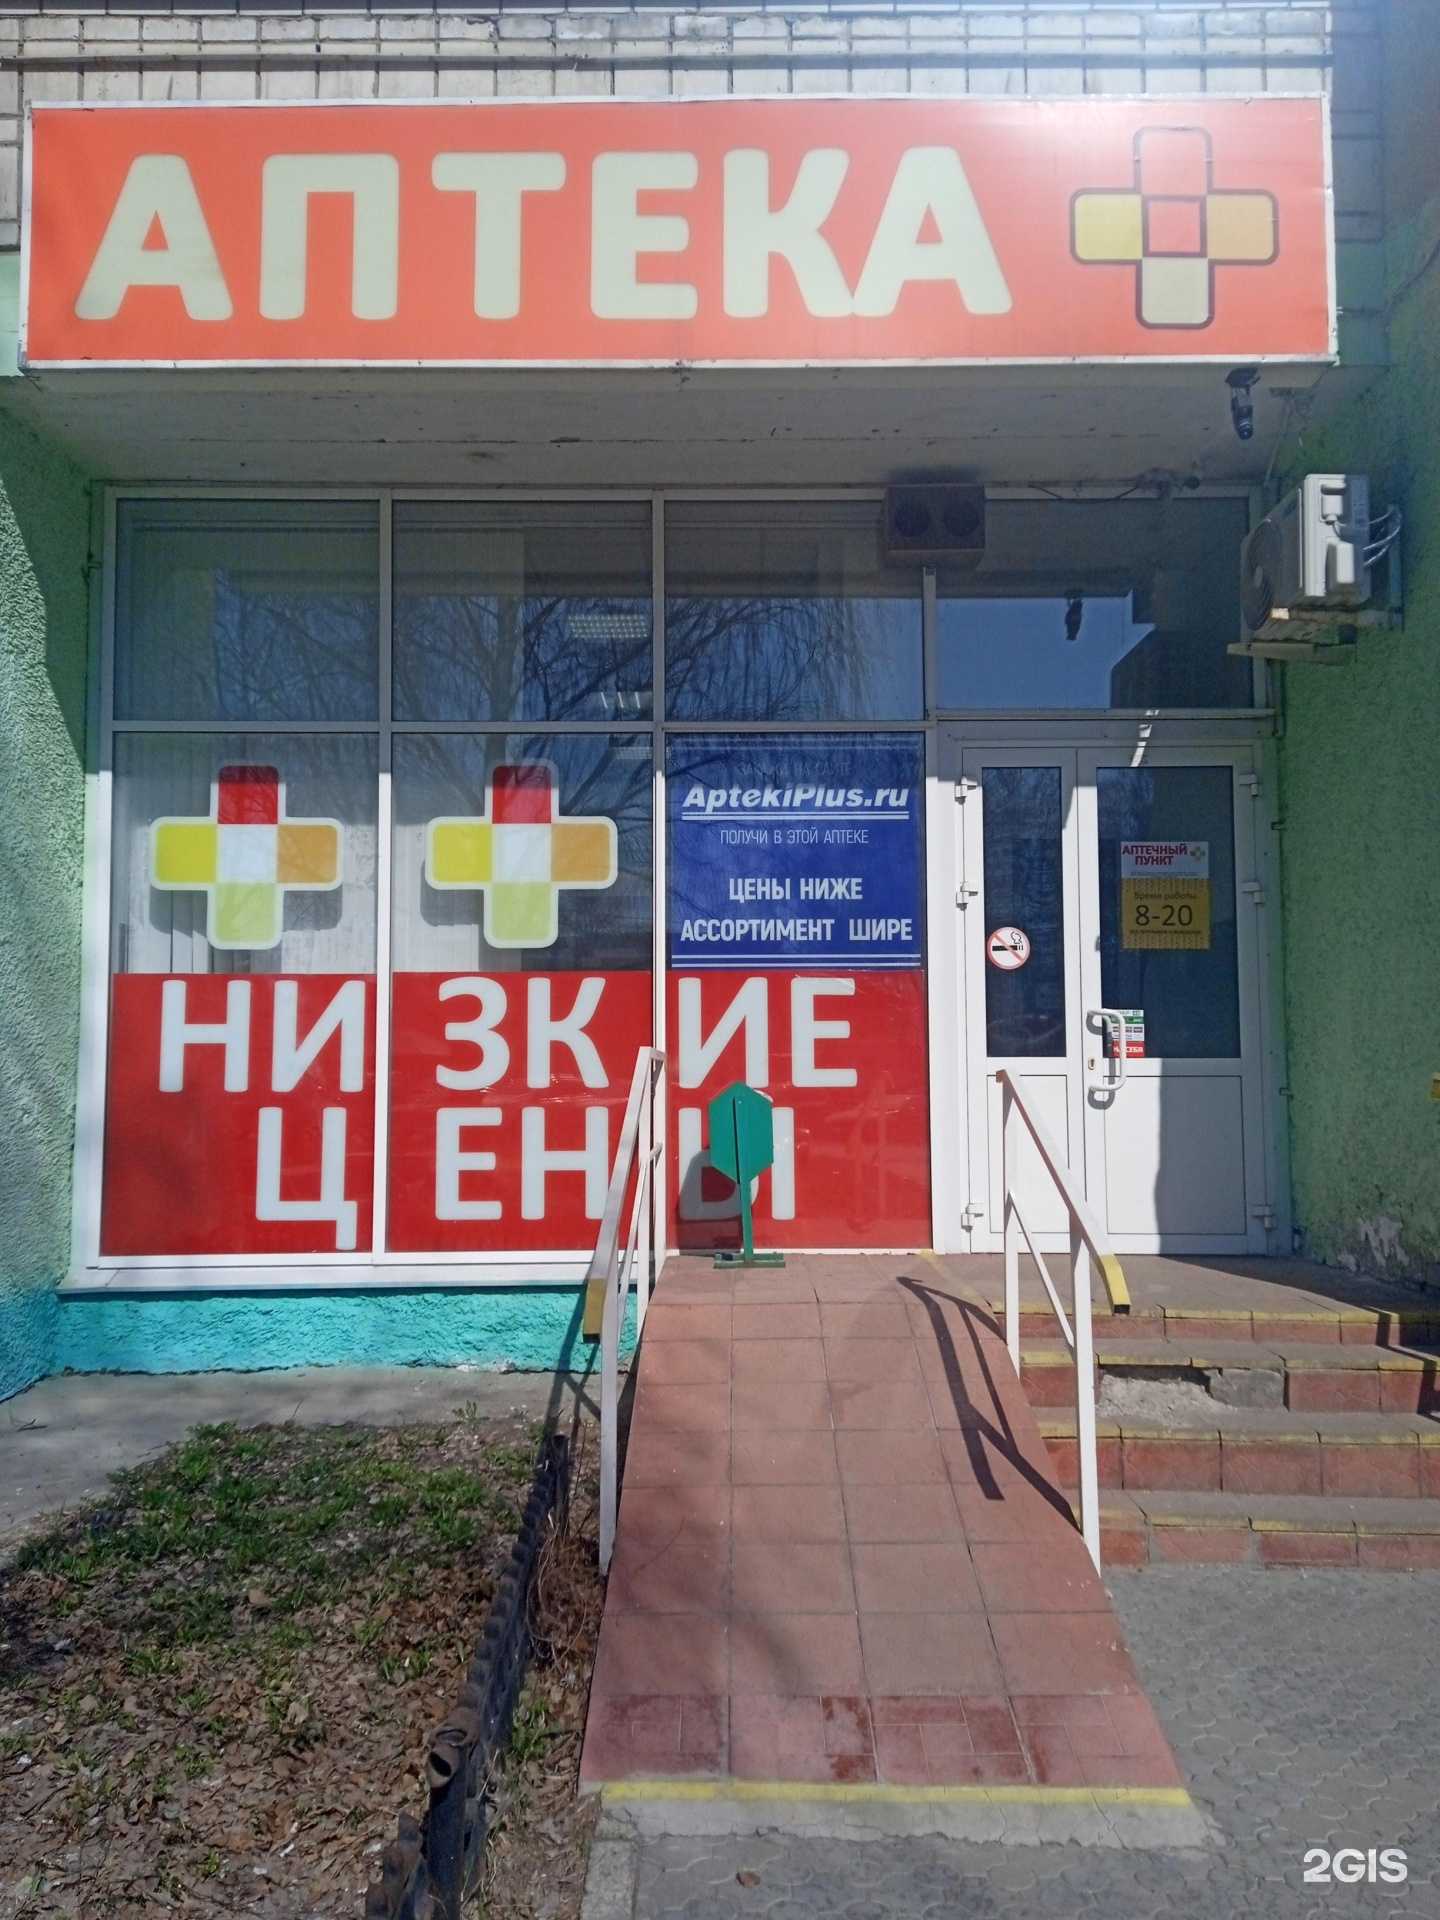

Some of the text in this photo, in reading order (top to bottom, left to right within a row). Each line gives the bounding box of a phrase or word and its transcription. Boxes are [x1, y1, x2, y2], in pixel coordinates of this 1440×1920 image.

[75, 146, 1013, 321] АПТЕКА
[682, 783, 909, 814] AptekiPlus.ru
[720, 826, 870, 844] ПОЛУЧИ В ЭТОЙ АПТЕКЕ
[1122, 843, 1188, 855] АПТЕЧНЫЙ
[1135, 855, 1174, 866] ПУНКТ
[729, 878, 863, 903] ЦЕНЫ НИЖЕ
[1135, 904, 1193, 926] 8-20
[680, 918, 913, 942] АССОРТИМЕНТ ШИРЕ
[158, 976, 858, 1093] НИЗКИЕ
